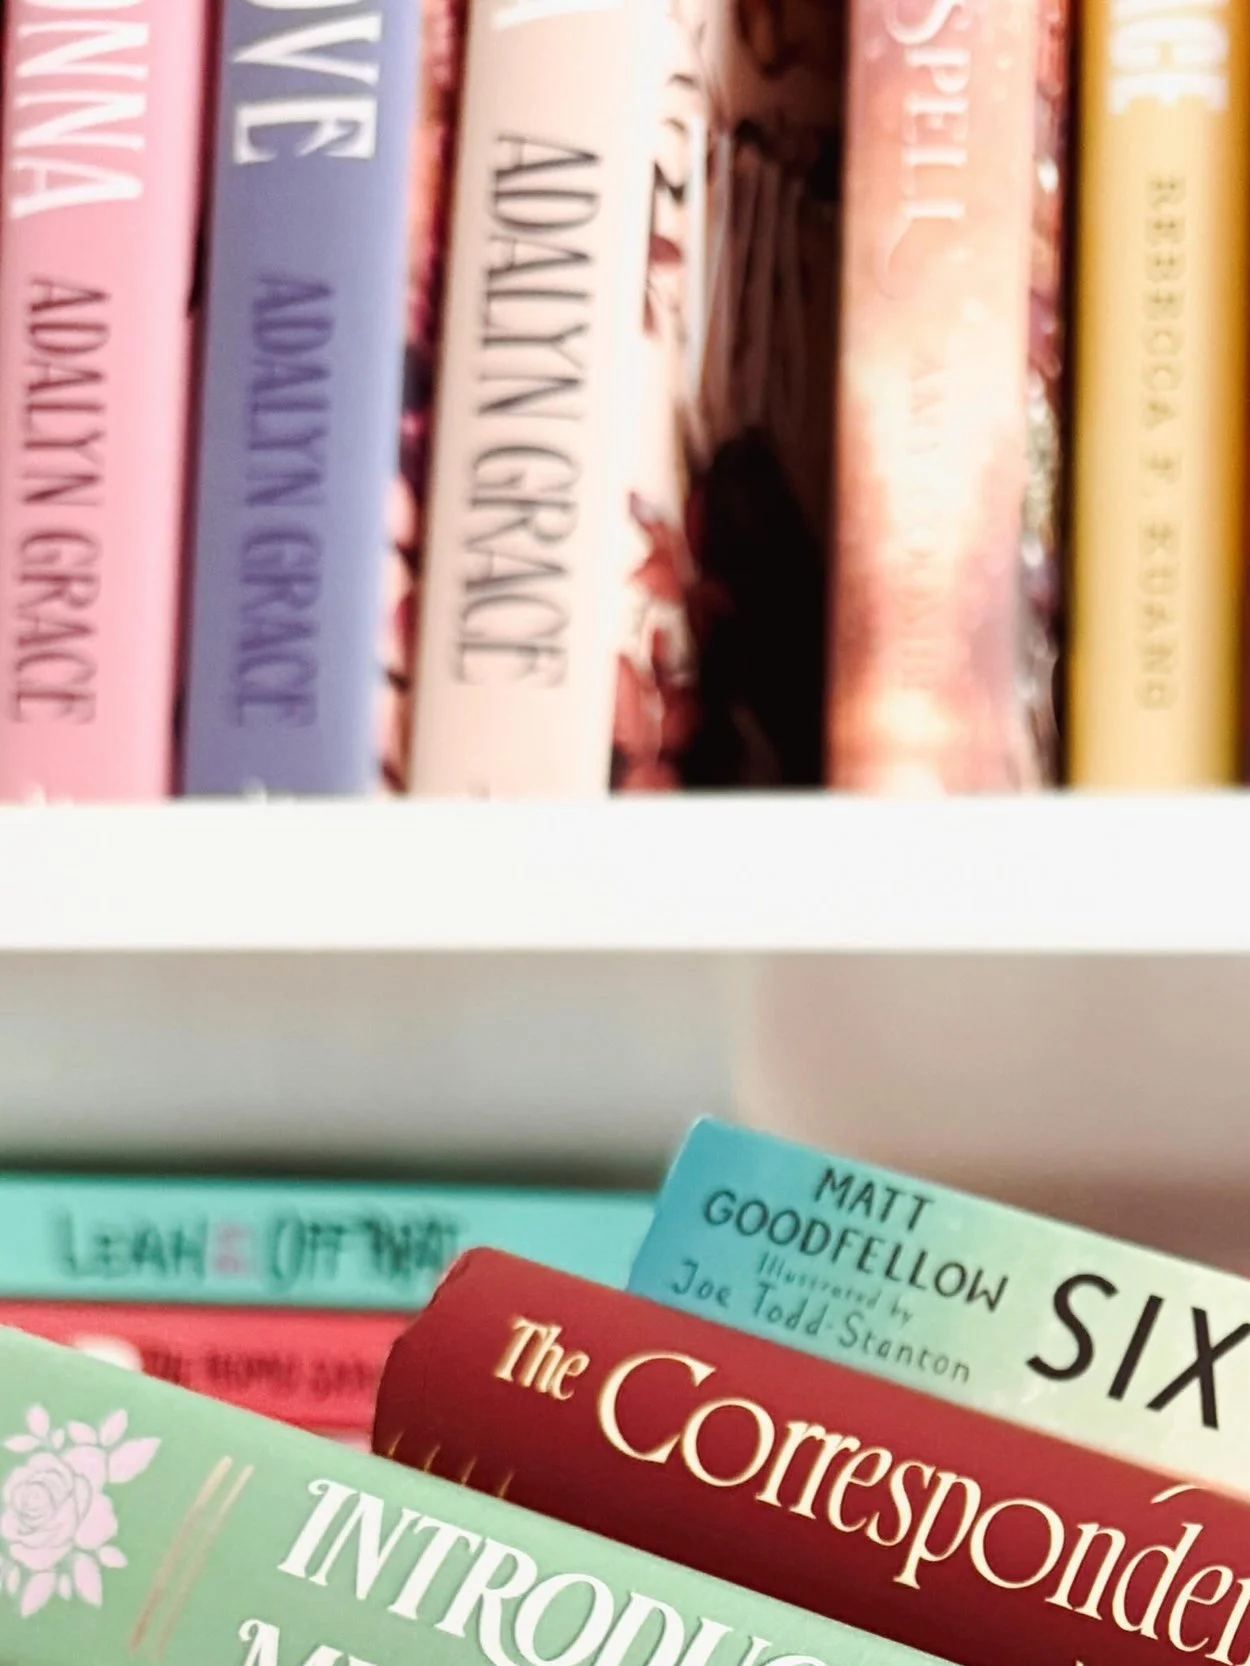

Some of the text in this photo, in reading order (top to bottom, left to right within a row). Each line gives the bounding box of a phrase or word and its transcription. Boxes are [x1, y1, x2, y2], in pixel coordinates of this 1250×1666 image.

[10, 0, 150, 219] NNA
[232, 0, 383, 165] VE
[478, 134, 601, 420] ADALYN
[1139, 172, 1187, 430] REBECCA
[12, 279, 110, 724] ADALYN GRACE
[236, 274, 334, 727] ADALYN GRACE
[455, 446, 579, 688] GRACE
[1132, 518, 1182, 712] KUANG
[671, 1257, 732, 1309] Joe
[703, 1189, 1009, 1312] GOODFELLOW
[757, 1252, 914, 1326] Illustrated by
[814, 1167, 933, 1231] MATT
[494, 1315, 591, 1401] The
